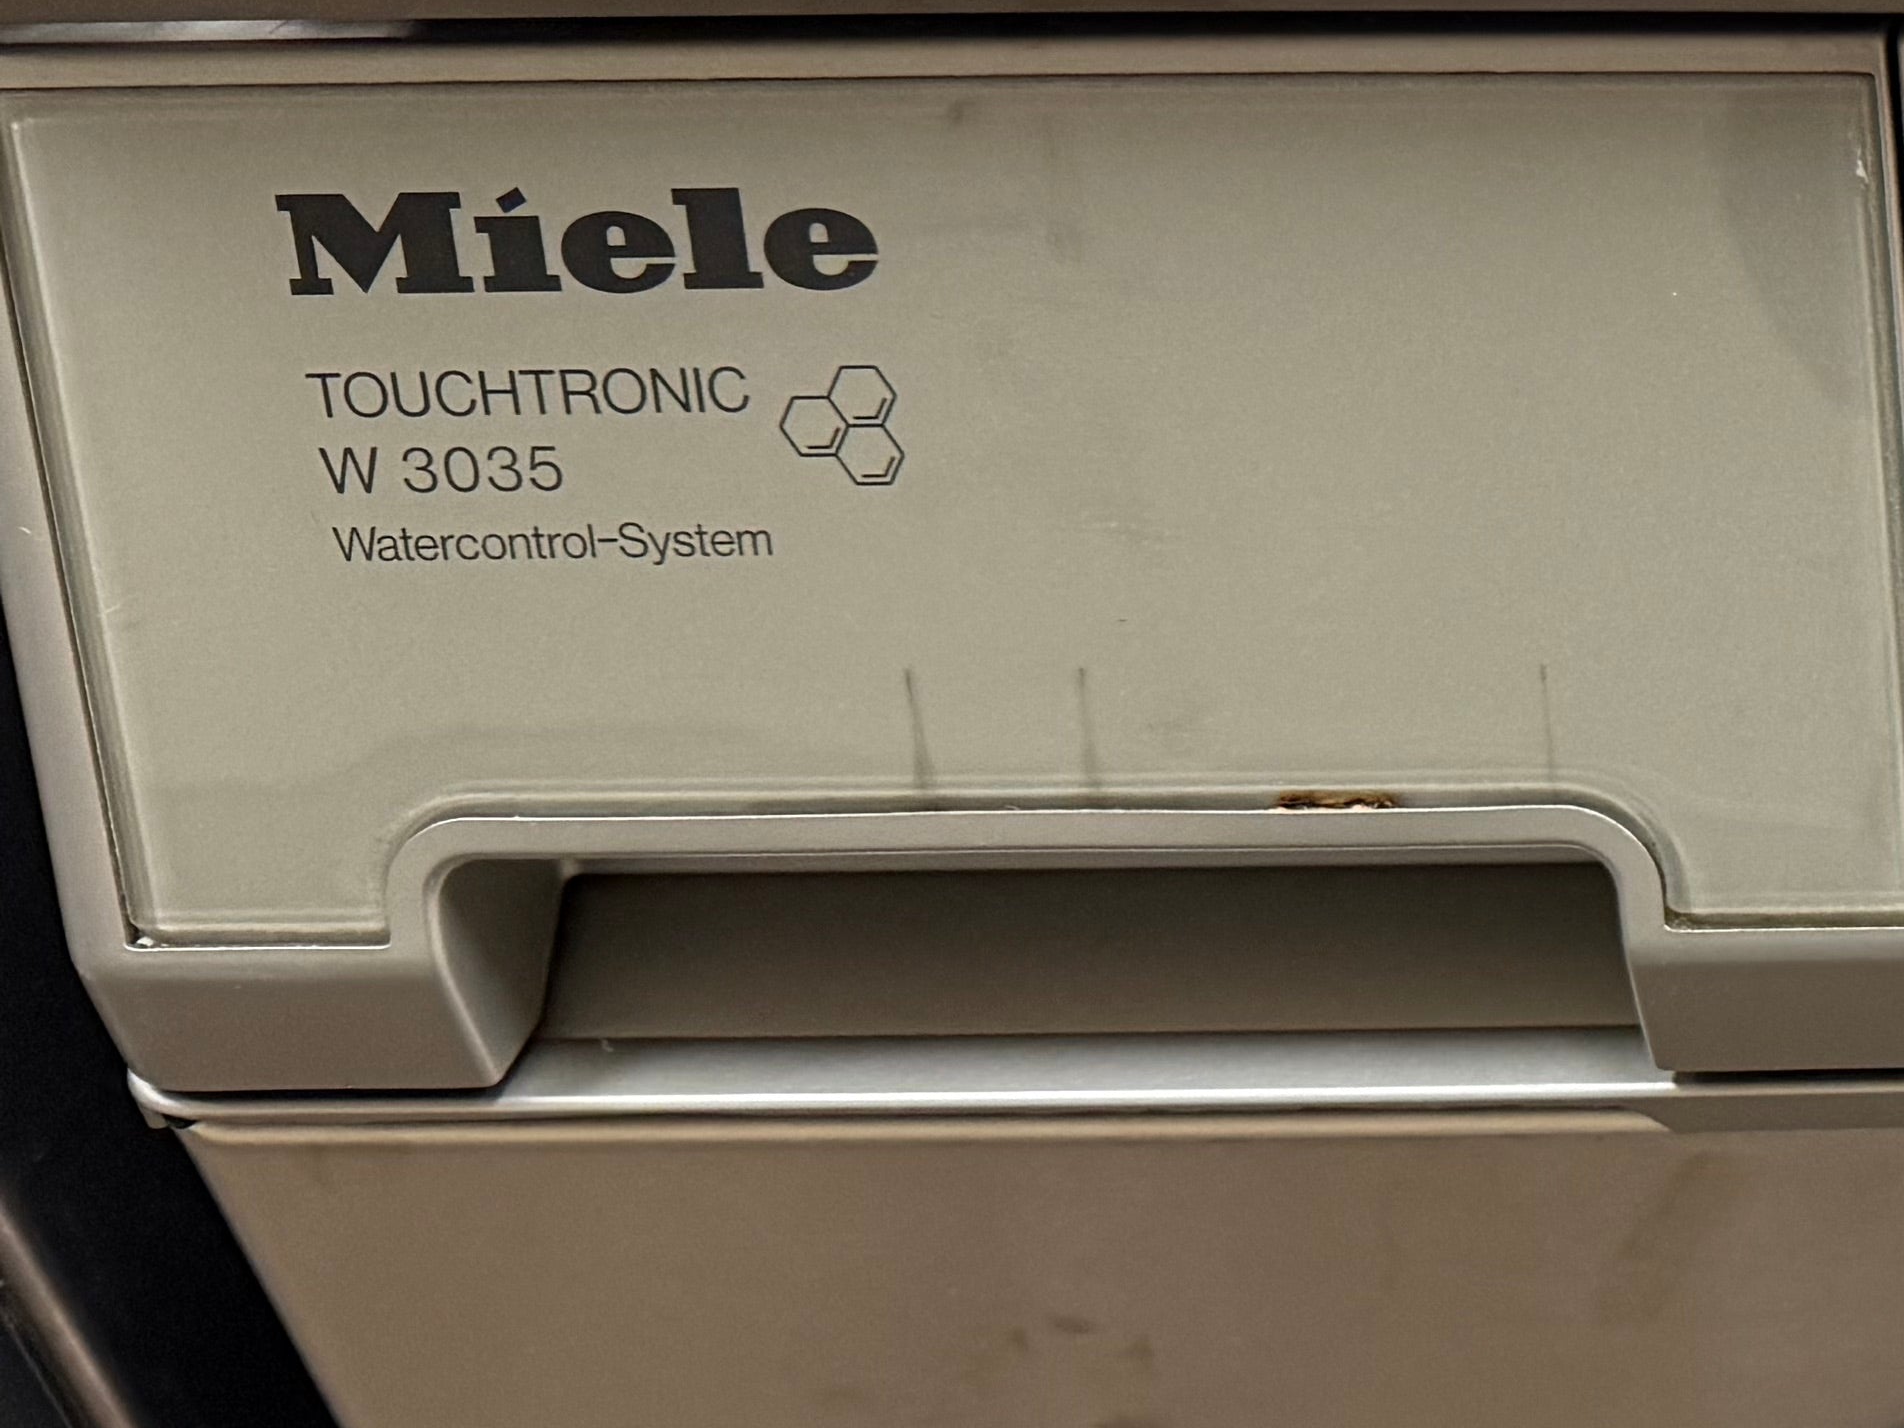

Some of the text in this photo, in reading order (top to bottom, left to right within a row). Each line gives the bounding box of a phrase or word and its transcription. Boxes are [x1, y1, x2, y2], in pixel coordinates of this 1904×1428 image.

[275, 187, 879, 295] Miele
[304, 365, 750, 418] TOUCHTRONIC
[318, 444, 565, 495] W 3035
[331, 522, 774, 565] Watercontrol-System
